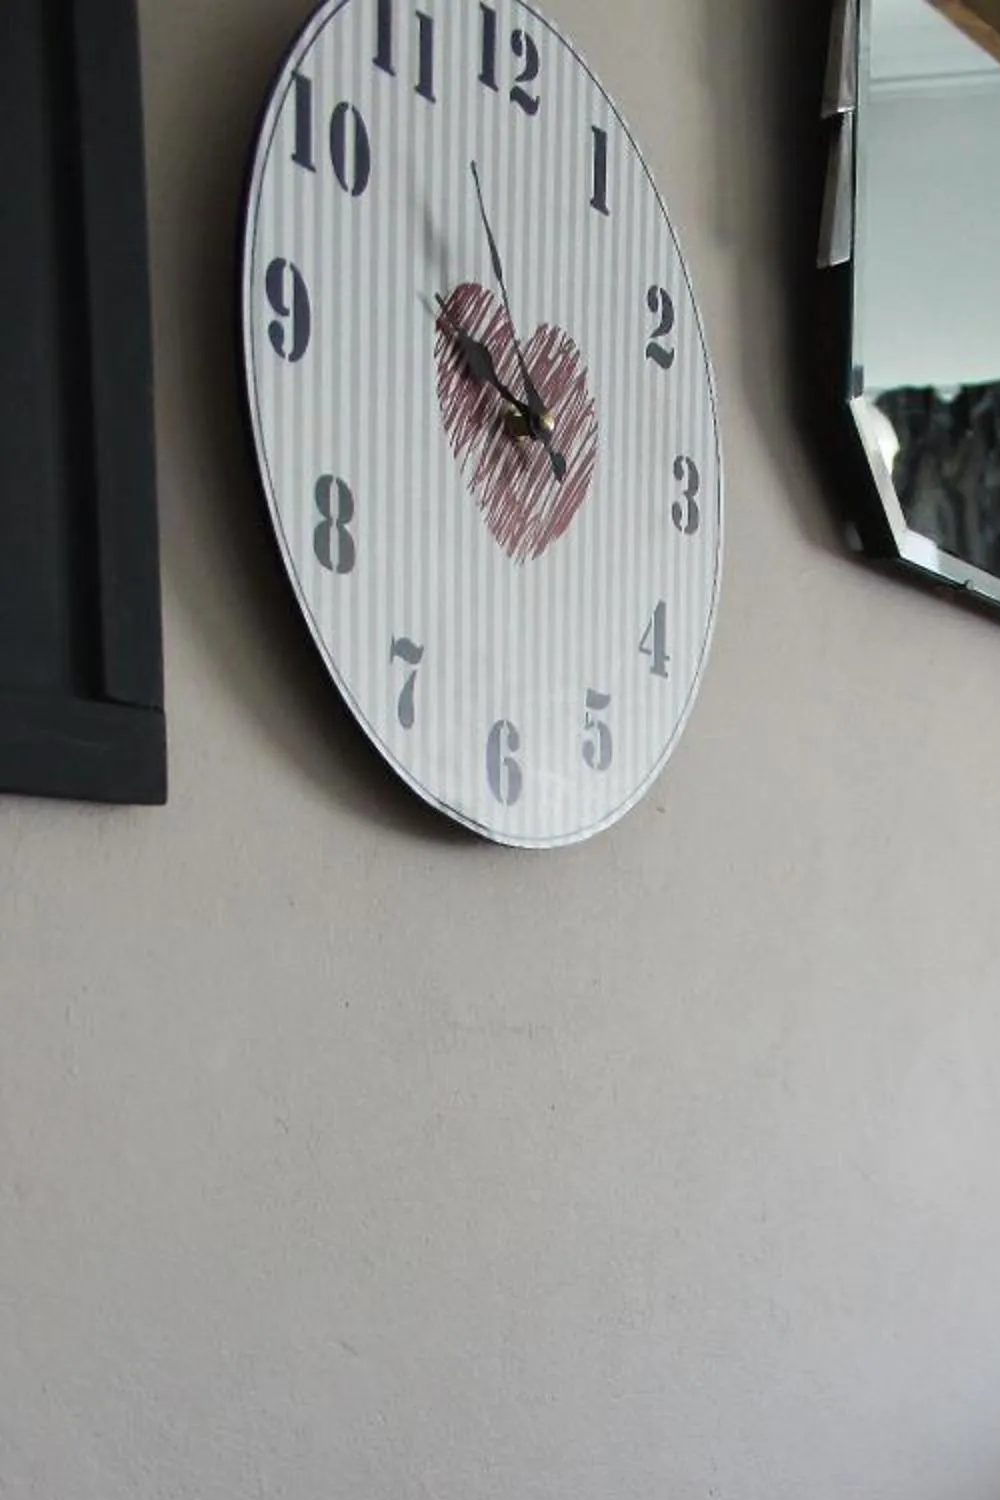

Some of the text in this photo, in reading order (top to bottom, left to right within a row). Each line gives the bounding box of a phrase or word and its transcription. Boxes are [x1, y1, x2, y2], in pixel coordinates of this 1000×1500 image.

[373, 0, 437, 104] 11
[478, 2, 541, 116] 12
[291, 70, 371, 197] 10
[590, 125, 610, 217] 1
[265, 257, 311, 363] 9
[645, 284, 675, 370] 2
[313, 474, 356, 575] 8
[671, 455, 700, 535] 3
[389, 634, 425, 730] 7
[638, 600, 671, 679] 4
[485, 719, 523, 806] 6
[582, 688, 613, 771] 5
